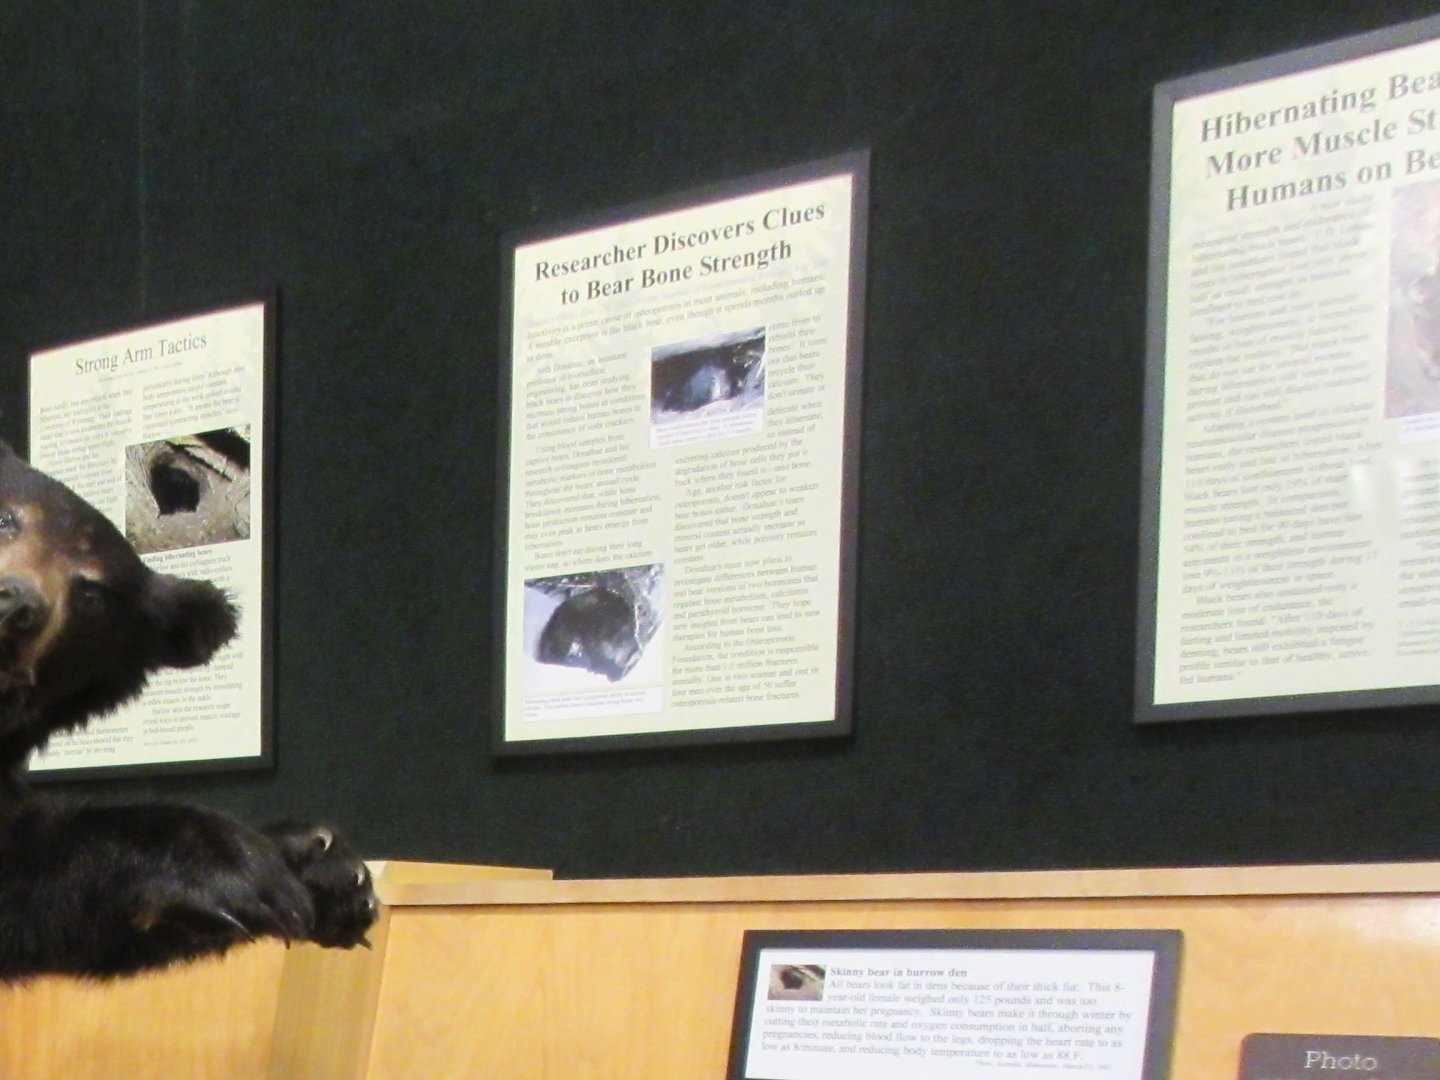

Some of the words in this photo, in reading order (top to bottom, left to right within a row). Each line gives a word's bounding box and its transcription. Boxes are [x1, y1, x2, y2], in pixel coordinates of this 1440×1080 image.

[1200, 87, 1376, 144] Hibernating
[1206, 145, 1282, 179] More
[1292, 119, 1397, 160] Muscle
[1226, 170, 1347, 212] Humans
[1357, 161, 1392, 184] on
[534, 241, 647, 281] Researcher
[653, 217, 755, 256] Discovers
[762, 203, 826, 231] Clues
[561, 286, 579, 306] to
[586, 274, 634, 302] Bear
[640, 263, 693, 290] Bone
[699, 239, 792, 278] Strength
[75, 354, 118, 376] Strong
[122, 346, 153, 366] Arm
[158, 332, 207, 358] Tactics
[830, 967, 864, 977] Skinny
[867, 968, 890, 976] bear
[905, 968, 945, 976] burrow
[947, 968, 967, 977] den
[1304, 1050, 1377, 1071] Photo
